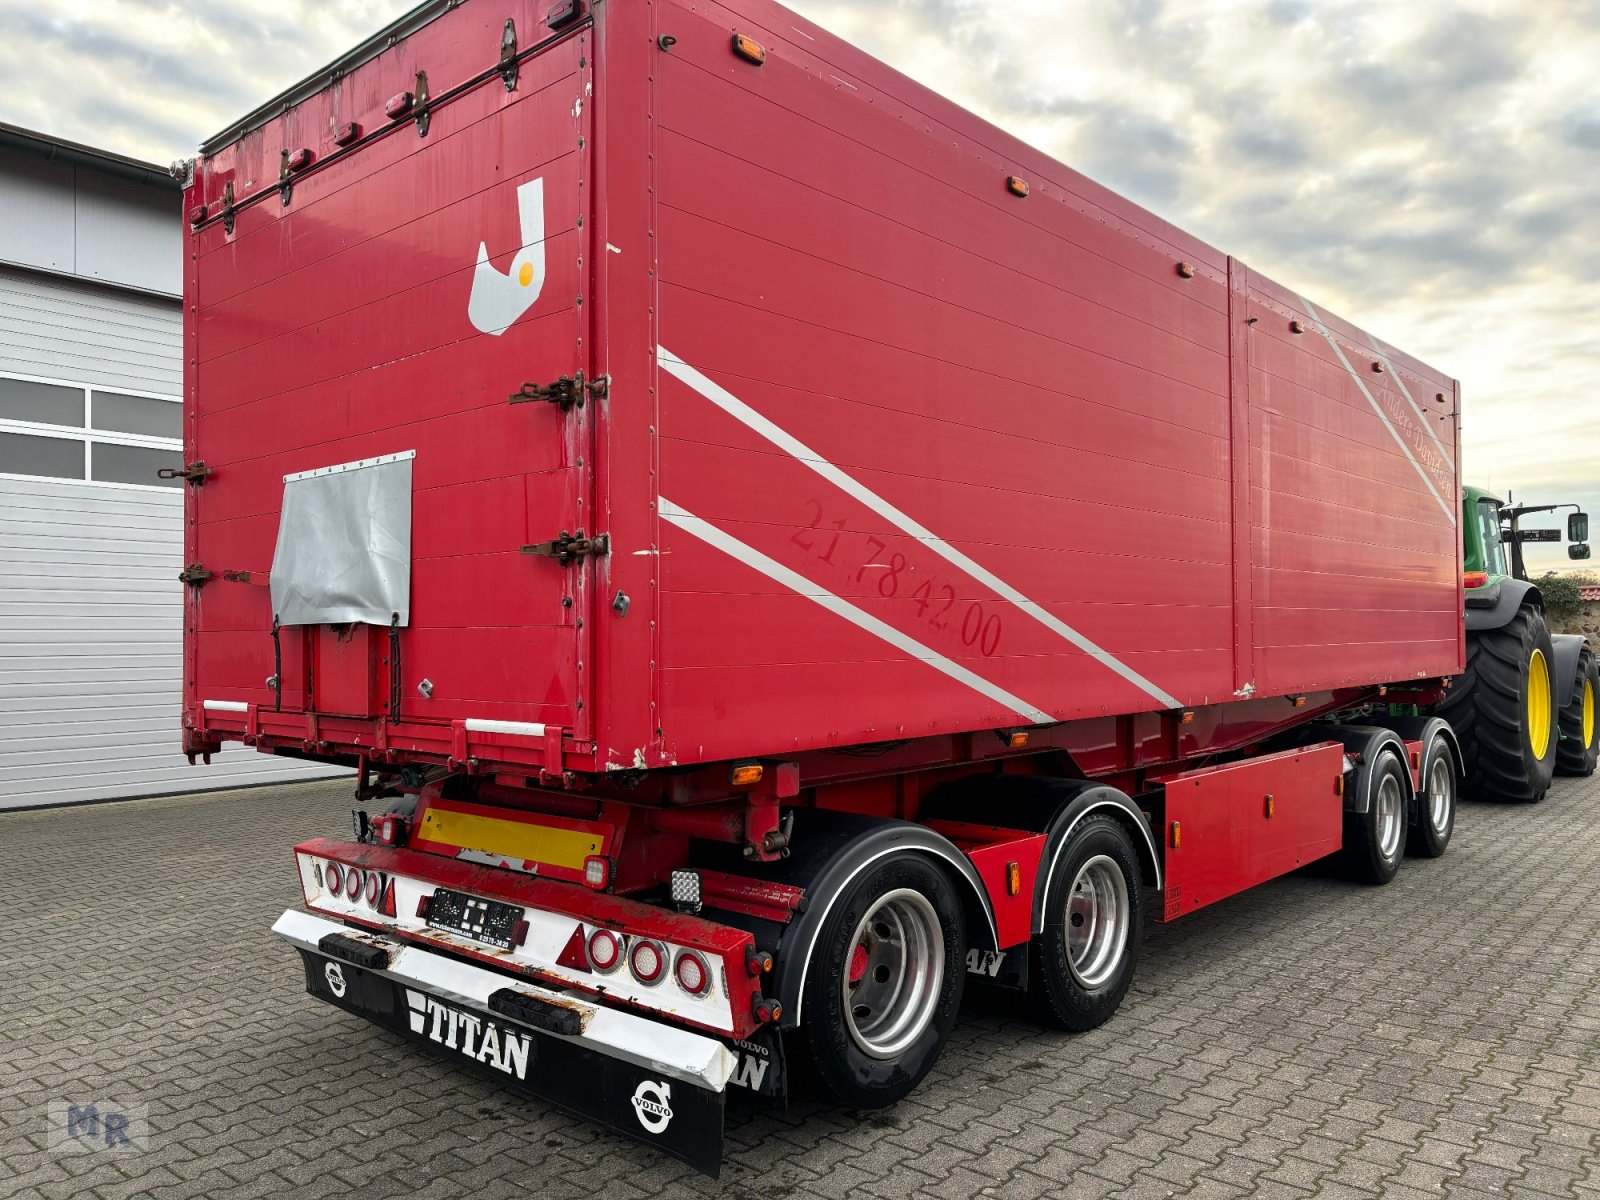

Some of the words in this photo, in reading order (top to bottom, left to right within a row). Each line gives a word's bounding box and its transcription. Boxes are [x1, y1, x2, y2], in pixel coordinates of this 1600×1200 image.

[1377, 376, 1413, 438] Anders
[1414, 426, 1452, 498] Davidsen
[789, 498, 848, 567] 21
[856, 534, 906, 598] 78
[911, 575, 955, 629] 42
[961, 602, 1002, 657] 00
[326, 973, 346, 986] VOLVO
[427, 997, 533, 1080] TITAN
[733, 1039, 769, 1056] VOLVO
[634, 1097, 671, 1117] VOLVO
